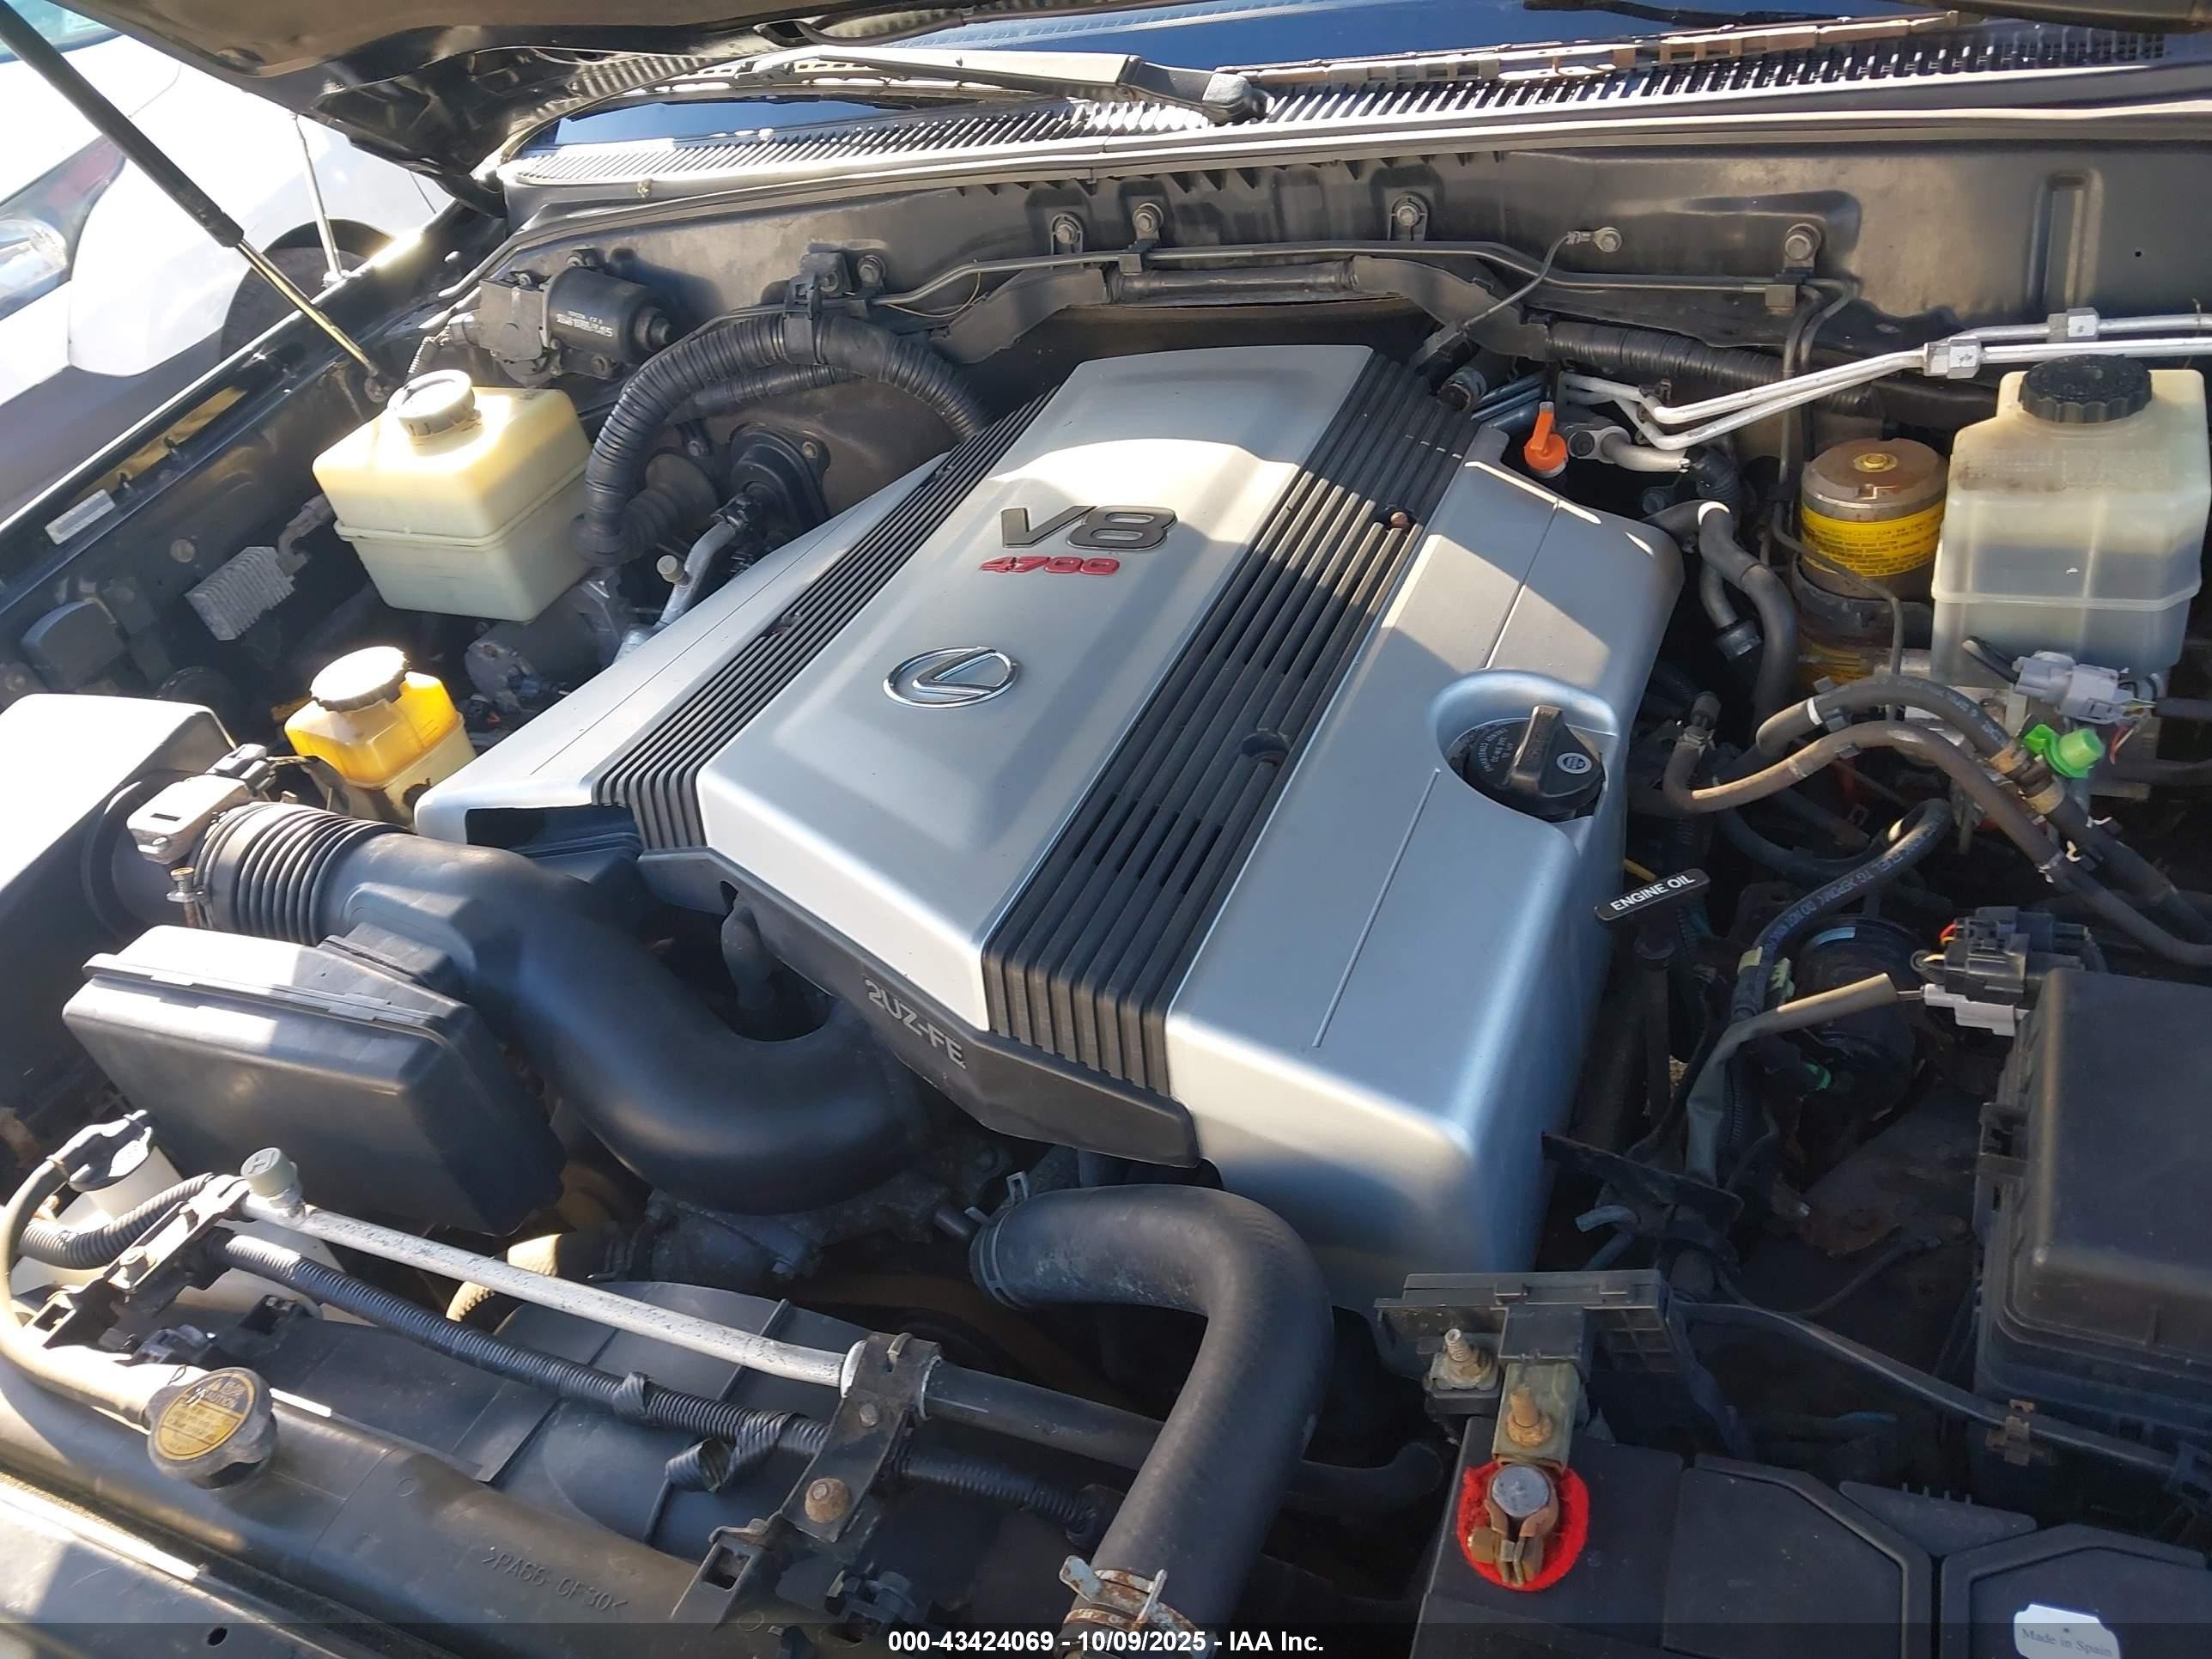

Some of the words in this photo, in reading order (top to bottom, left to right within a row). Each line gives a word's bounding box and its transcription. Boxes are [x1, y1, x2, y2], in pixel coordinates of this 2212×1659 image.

[1000, 505, 1178, 550] V8
[978, 556, 1120, 576] 4700
[1610, 883, 1669, 911] ENGINE
[1667, 875, 1696, 888] OIL
[865, 979, 966, 1070] 2UZ-FE
